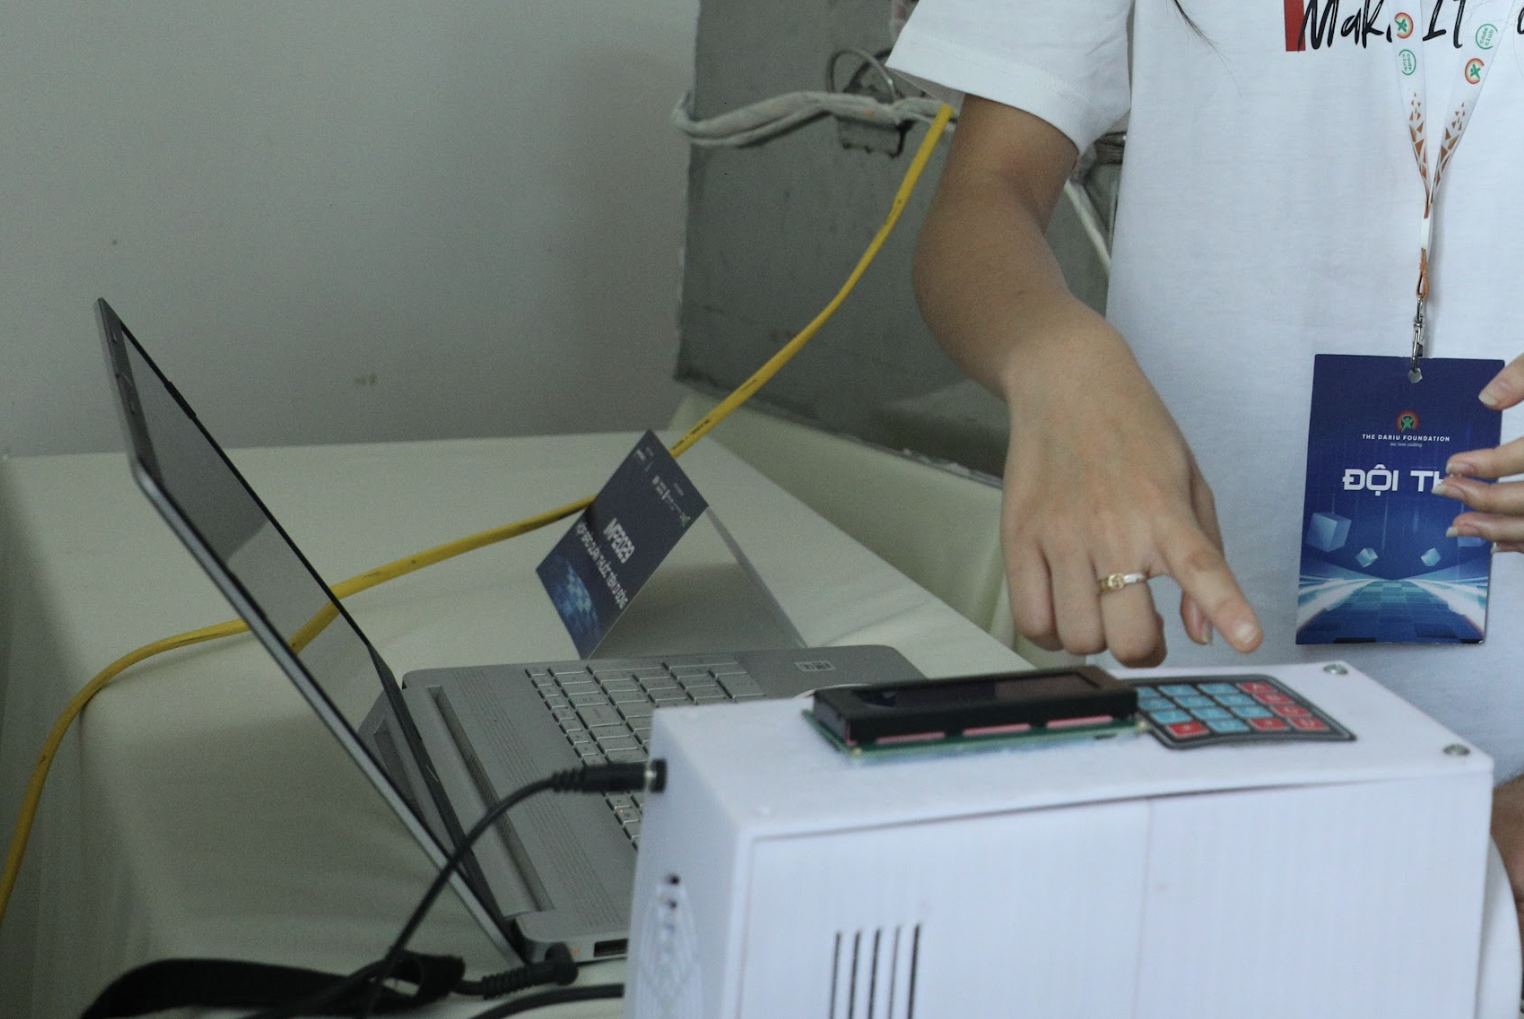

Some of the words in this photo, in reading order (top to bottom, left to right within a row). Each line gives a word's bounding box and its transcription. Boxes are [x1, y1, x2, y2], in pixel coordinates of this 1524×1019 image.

[1479, 27, 1489, 44] code
[1484, 29, 1494, 46] club
[1342, 464, 1399, 496] ĐỘI
